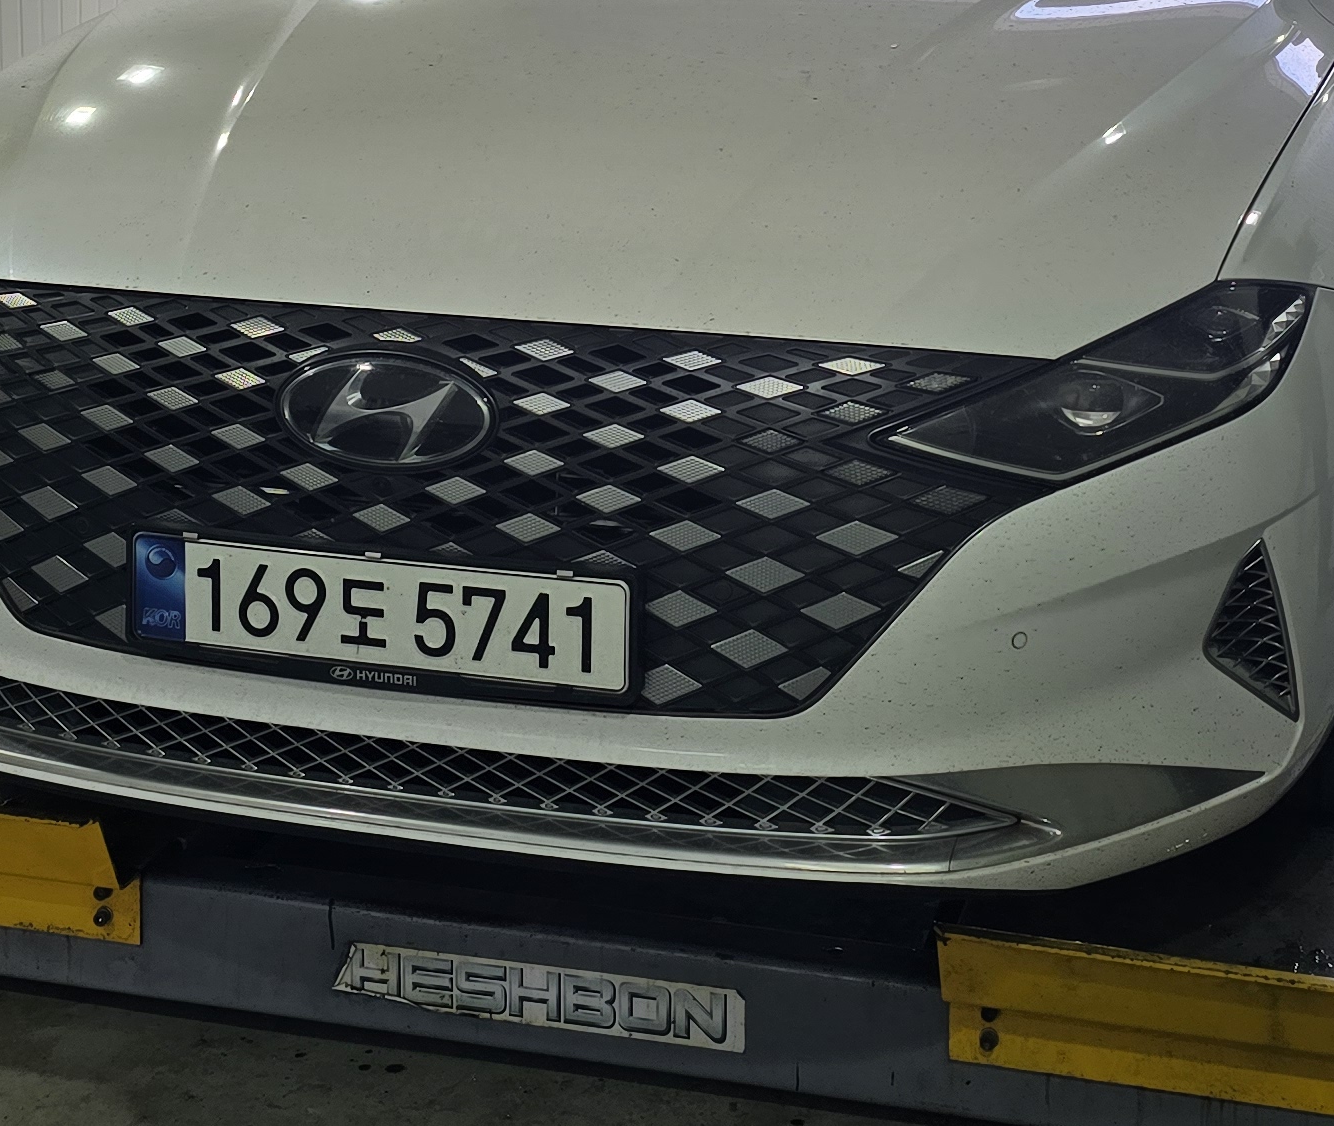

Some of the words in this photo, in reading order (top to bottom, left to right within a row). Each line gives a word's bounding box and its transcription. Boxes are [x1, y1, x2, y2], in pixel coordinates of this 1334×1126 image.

[142, 607, 182, 629] KOR
[196, 558, 387, 648] 169도
[413, 581, 593, 674] 5741
[356, 670, 417, 686] HYUNDAI
[351, 948, 728, 1044] HESHBON
